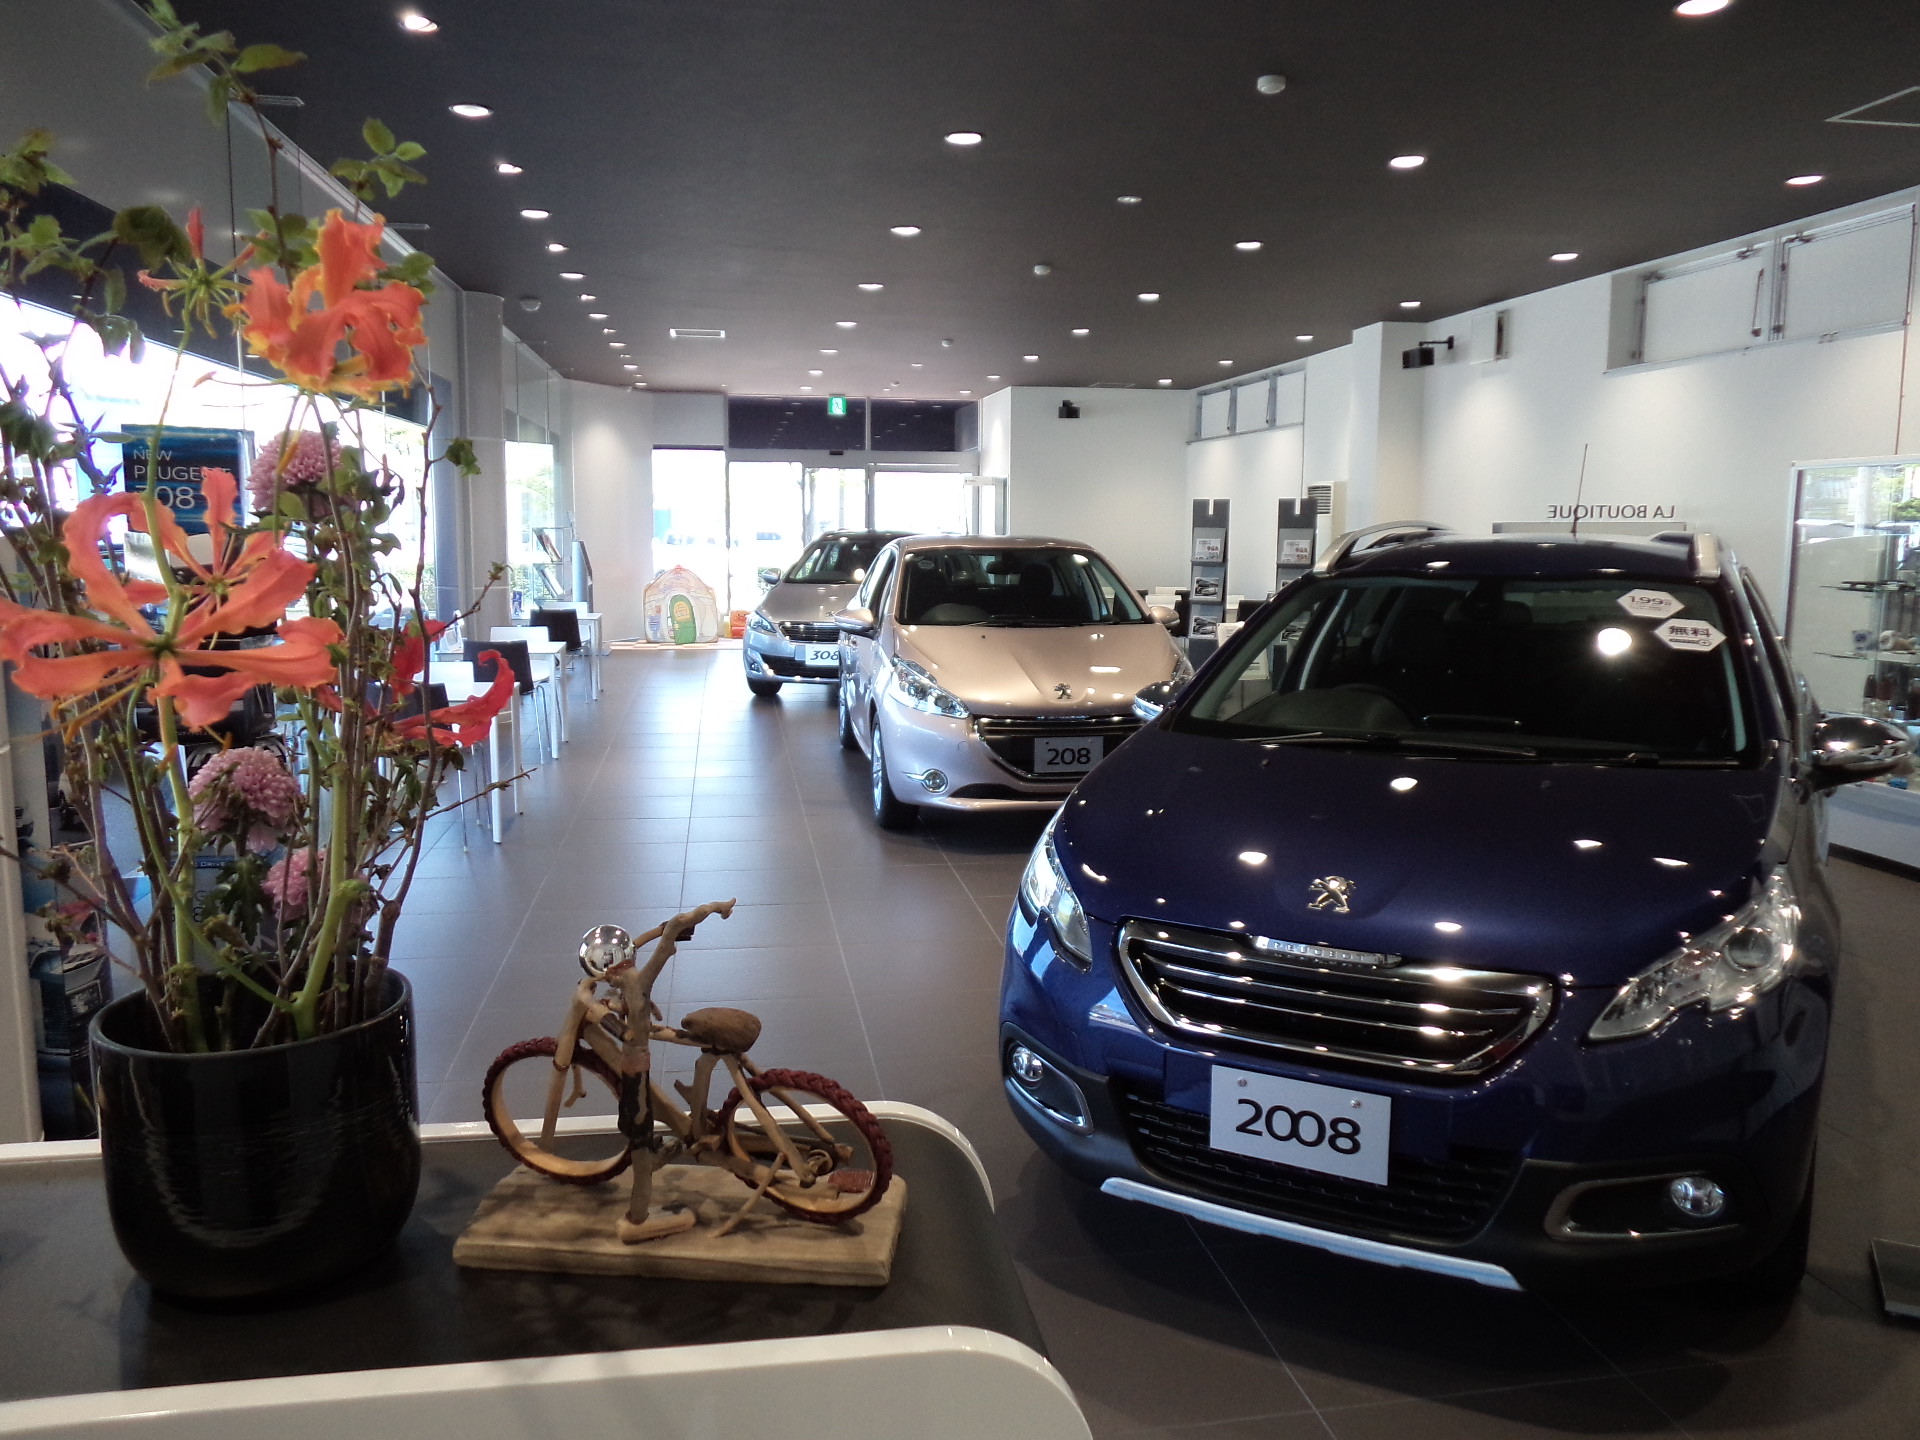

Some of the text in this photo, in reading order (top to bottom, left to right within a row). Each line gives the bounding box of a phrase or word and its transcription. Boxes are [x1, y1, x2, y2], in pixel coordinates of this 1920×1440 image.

[134, 464, 232, 481] PUGE
[135, 484, 195, 509] 08
[1668, 625, 1711, 637] 無料
[810, 650, 839, 661] 308
[1046, 747, 1091, 766] 208
[1235, 1098, 1361, 1155] 2008
